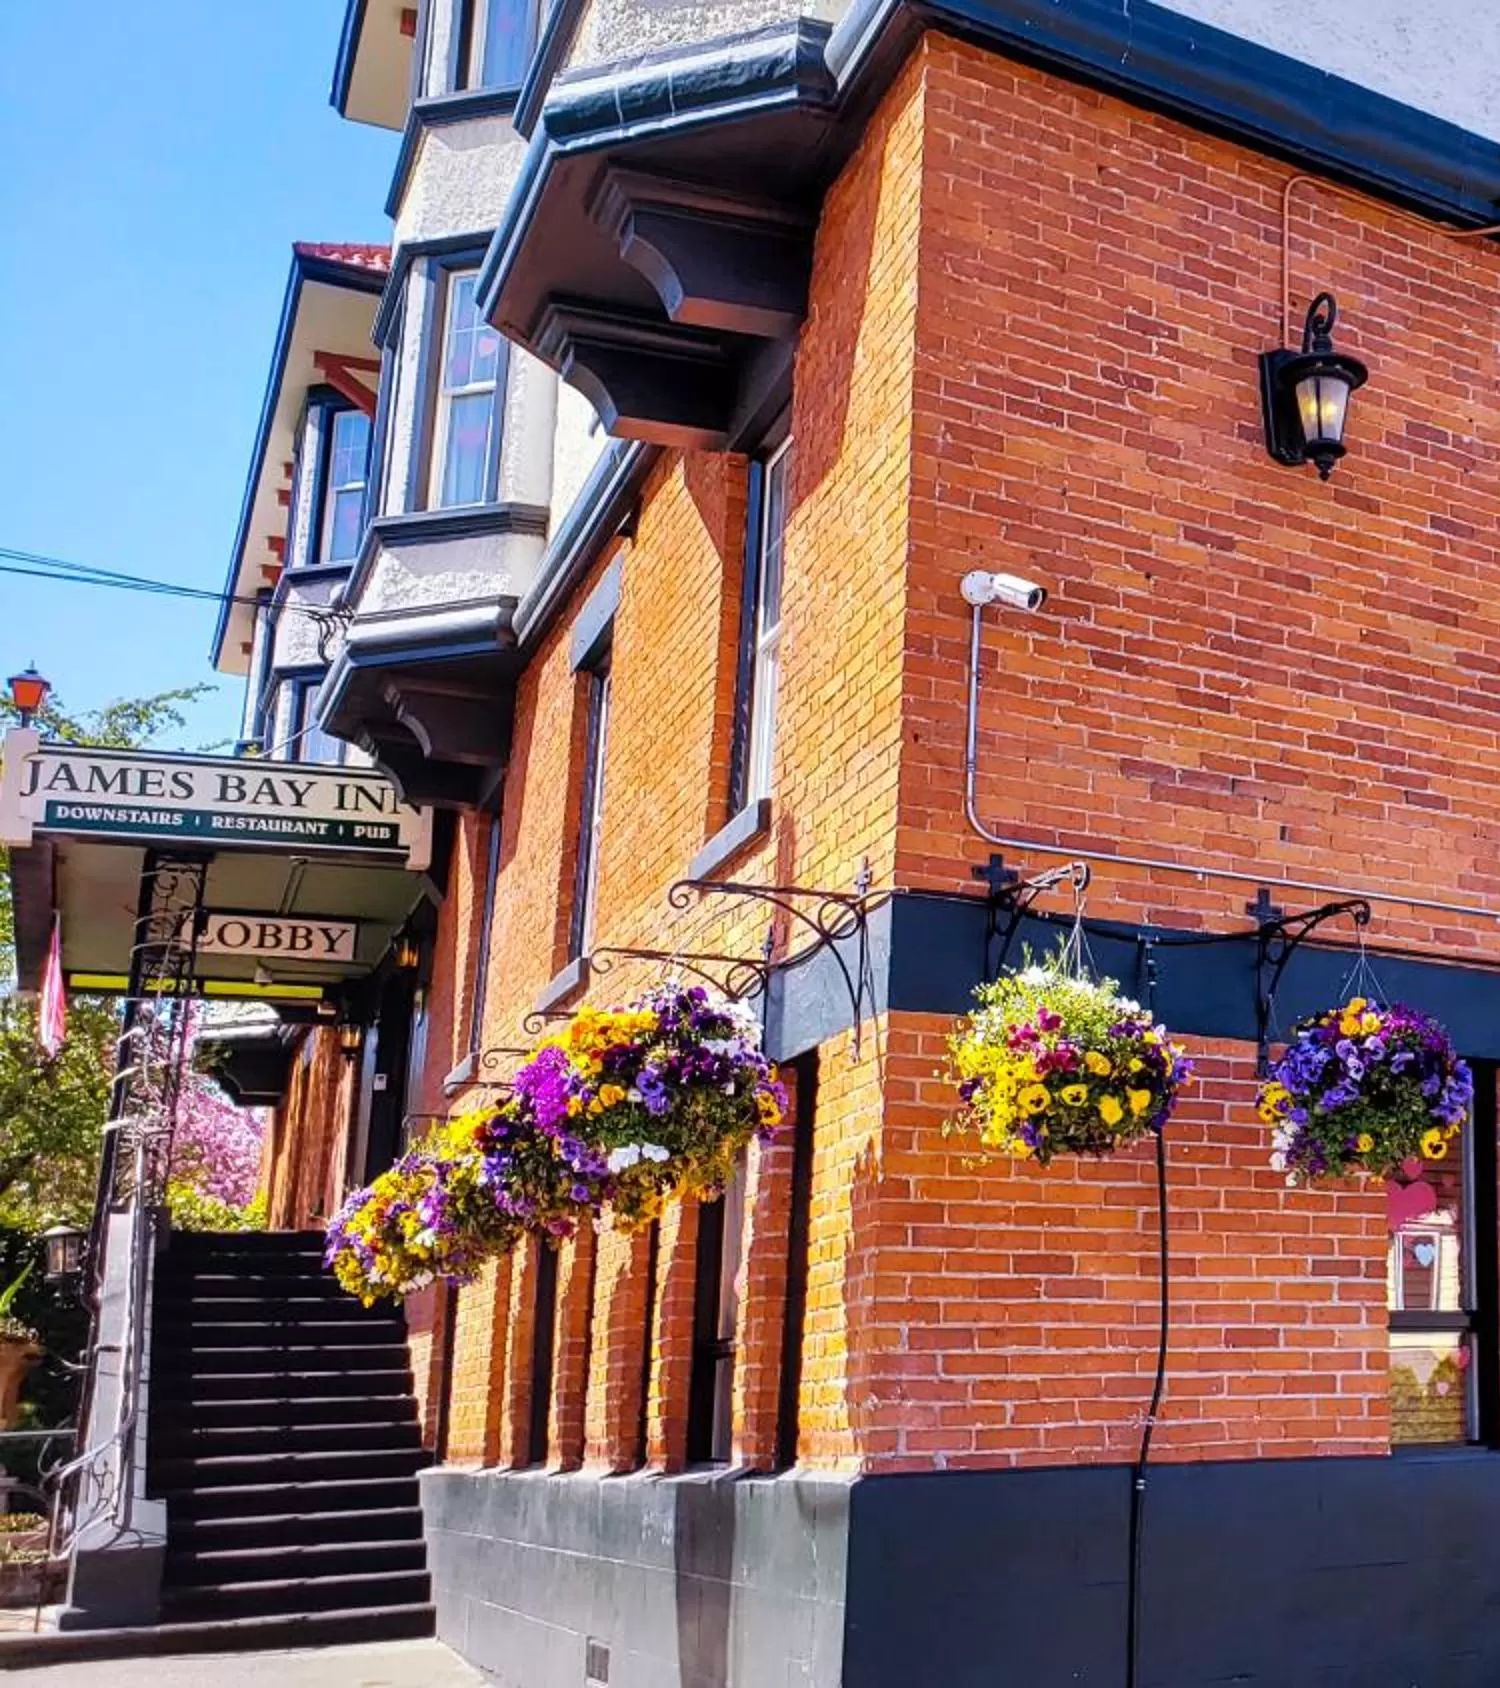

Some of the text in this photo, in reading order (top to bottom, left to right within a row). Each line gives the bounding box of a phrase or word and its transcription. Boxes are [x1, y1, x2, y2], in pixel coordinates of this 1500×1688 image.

[19, 758, 195, 800] JAMES
[214, 773, 317, 808] BAY
[56, 805, 390, 839] DOWNSTAIRS RESTAURANT PUB
